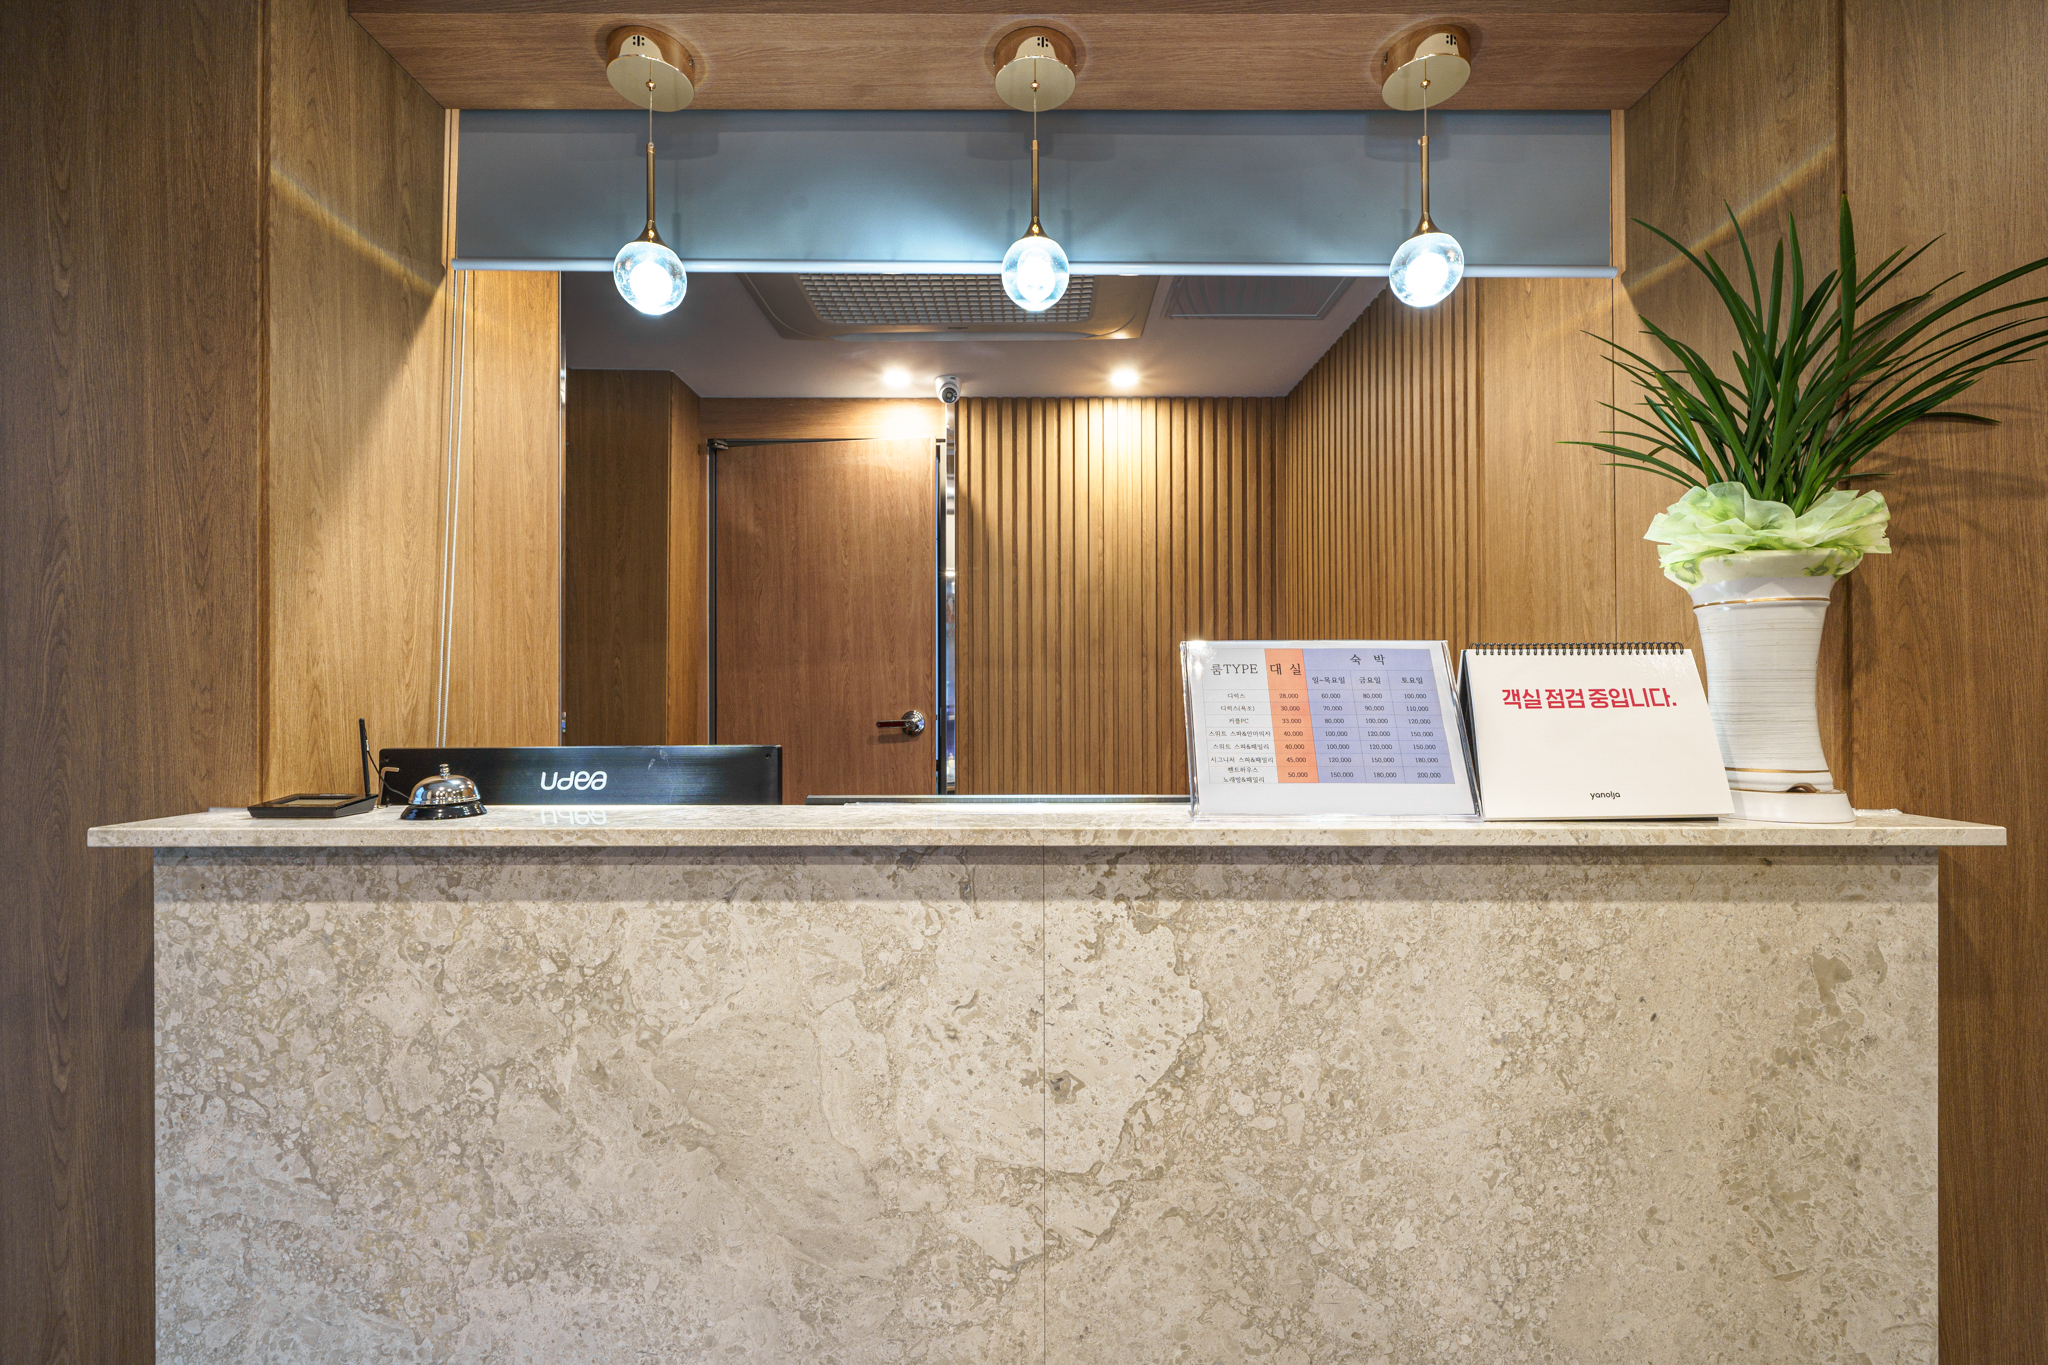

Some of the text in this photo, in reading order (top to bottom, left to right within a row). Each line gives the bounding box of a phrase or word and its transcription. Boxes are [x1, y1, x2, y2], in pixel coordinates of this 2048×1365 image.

[1210, 663, 1258, 675] 룸TYPE
[1358, 676, 1381, 684] 금요일
[1401, 677, 1423, 685] 토요일
[1501, 687, 1677, 710] 객실 점검 중입니다.
[1590, 791, 1621, 800] yanolja
